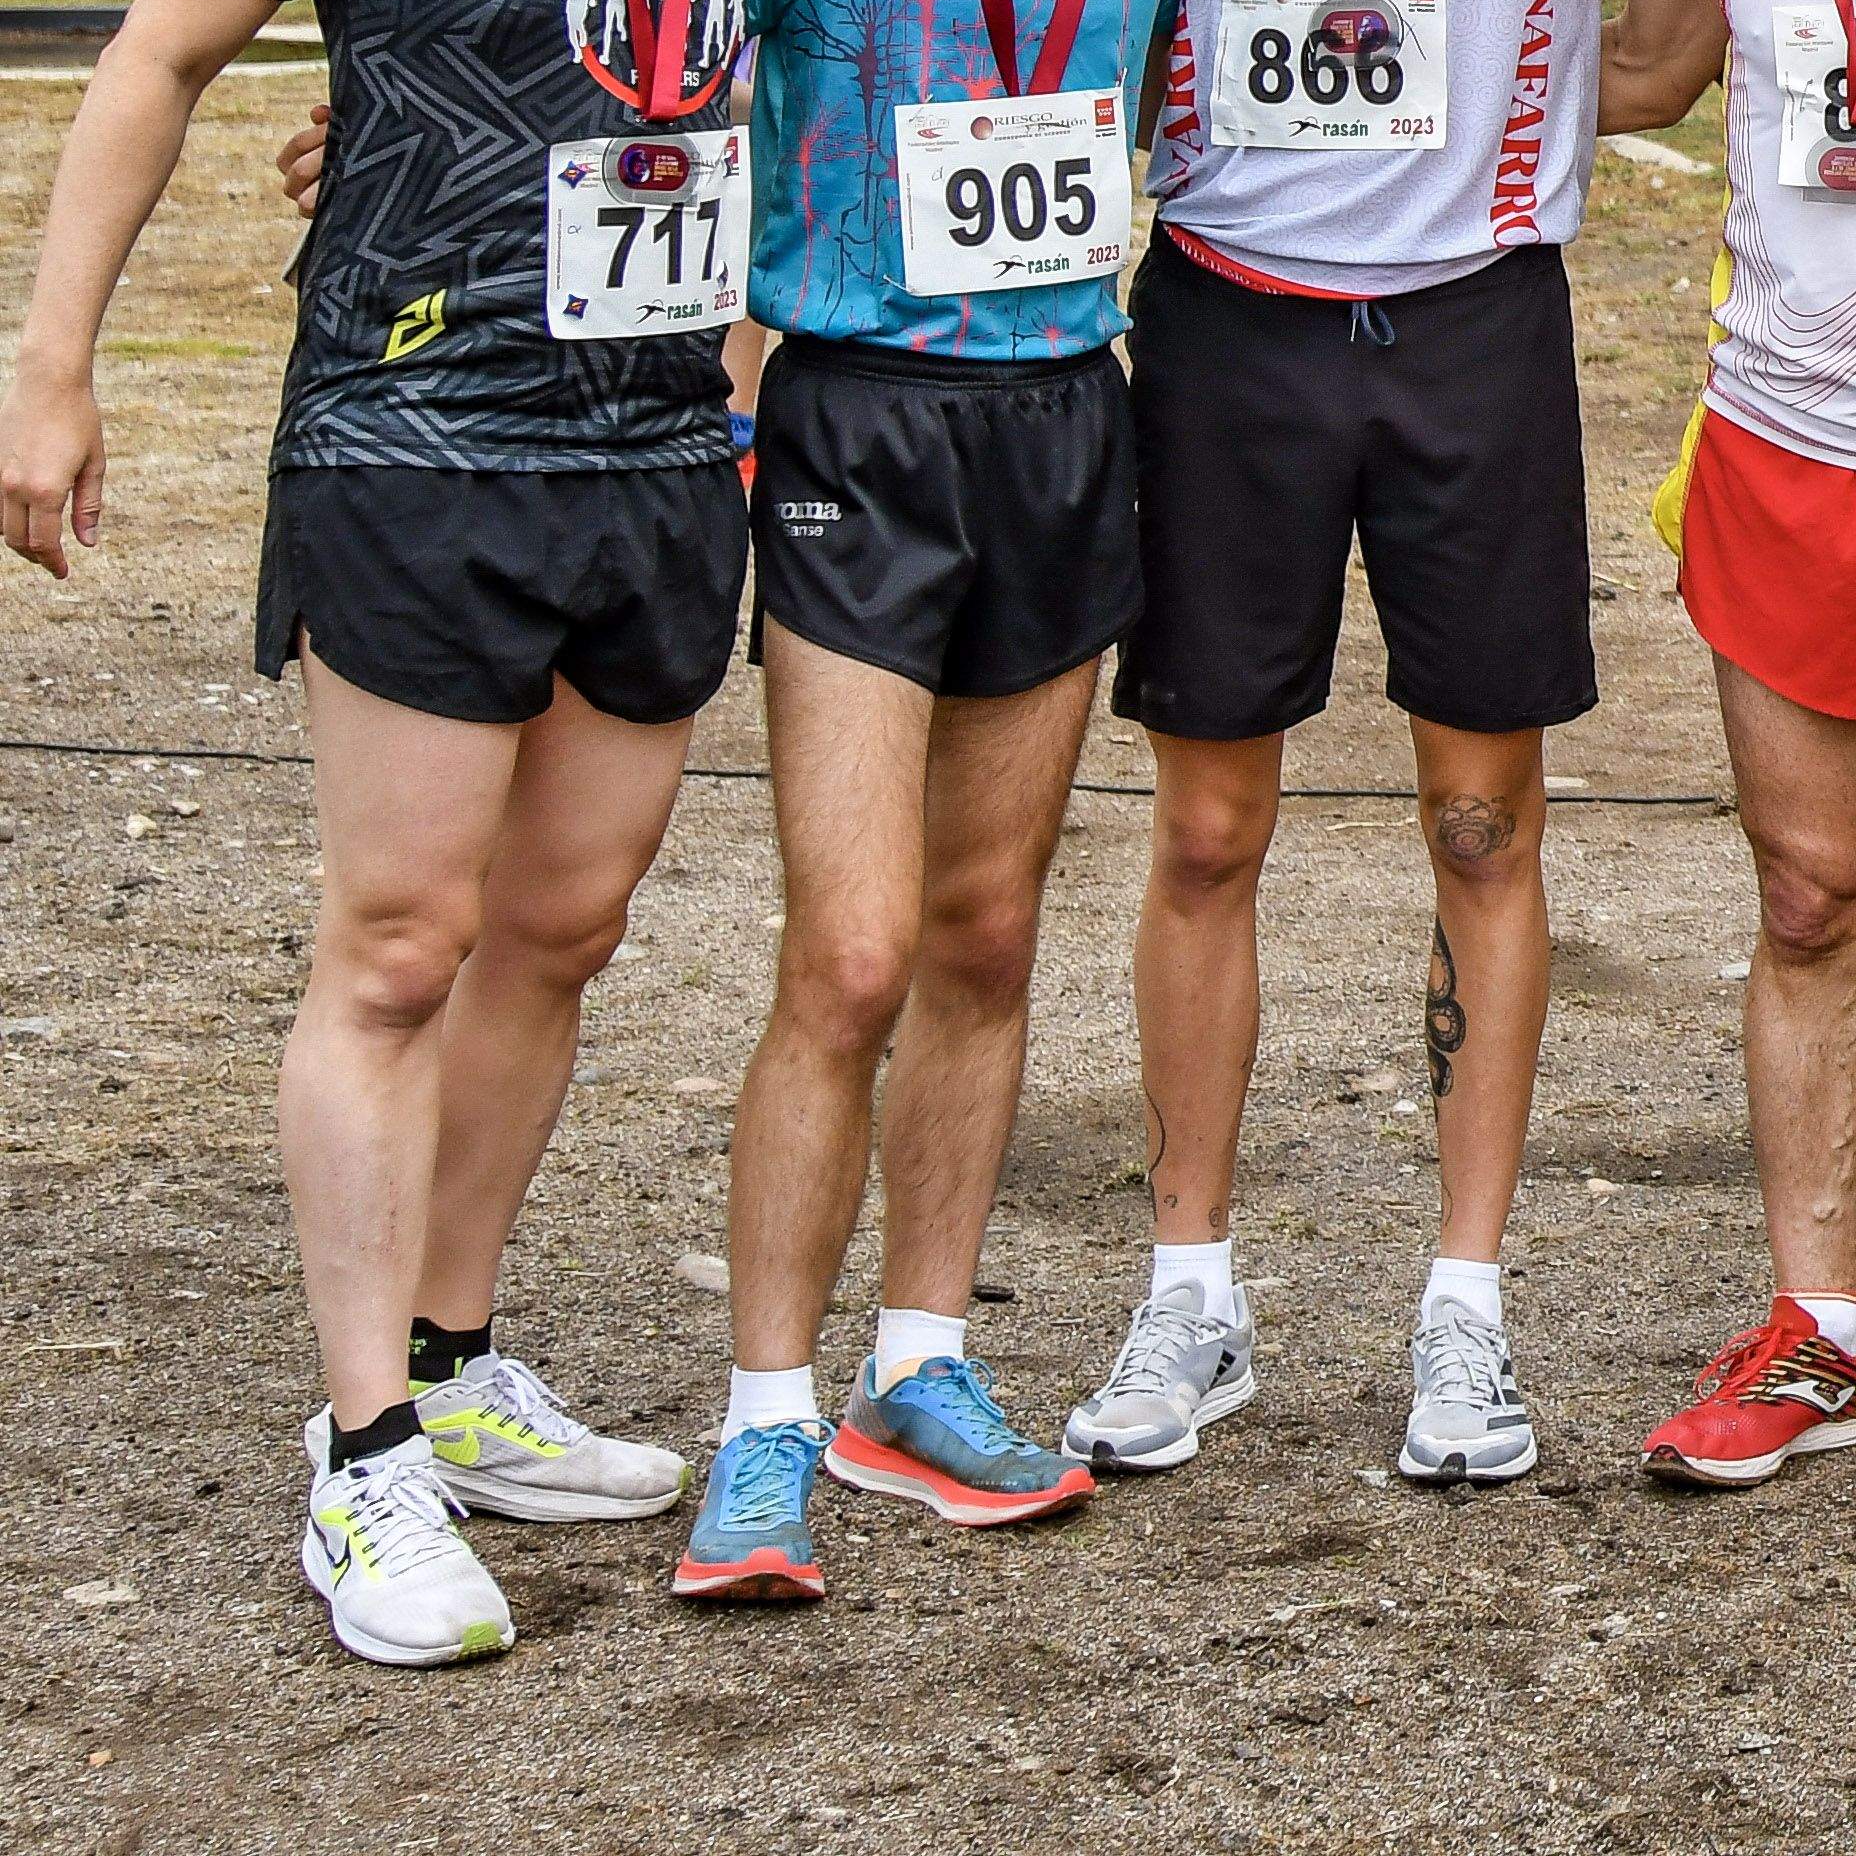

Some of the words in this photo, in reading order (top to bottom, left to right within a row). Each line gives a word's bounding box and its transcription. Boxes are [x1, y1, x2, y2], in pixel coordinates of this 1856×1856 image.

[1248, 28, 1404, 105] 866
[994, 113, 1053, 127] RIESGO
[1322, 119, 1369, 137] rasán
[1390, 118, 1434, 136] 2023
[945, 157, 1096, 247] 905
[597, 198, 721, 289] 717
[1027, 253, 1070, 274] rasán
[1087, 244, 1120, 265] 2023
[666, 299, 703, 320] rasán
[713, 290, 738, 311] 2023
